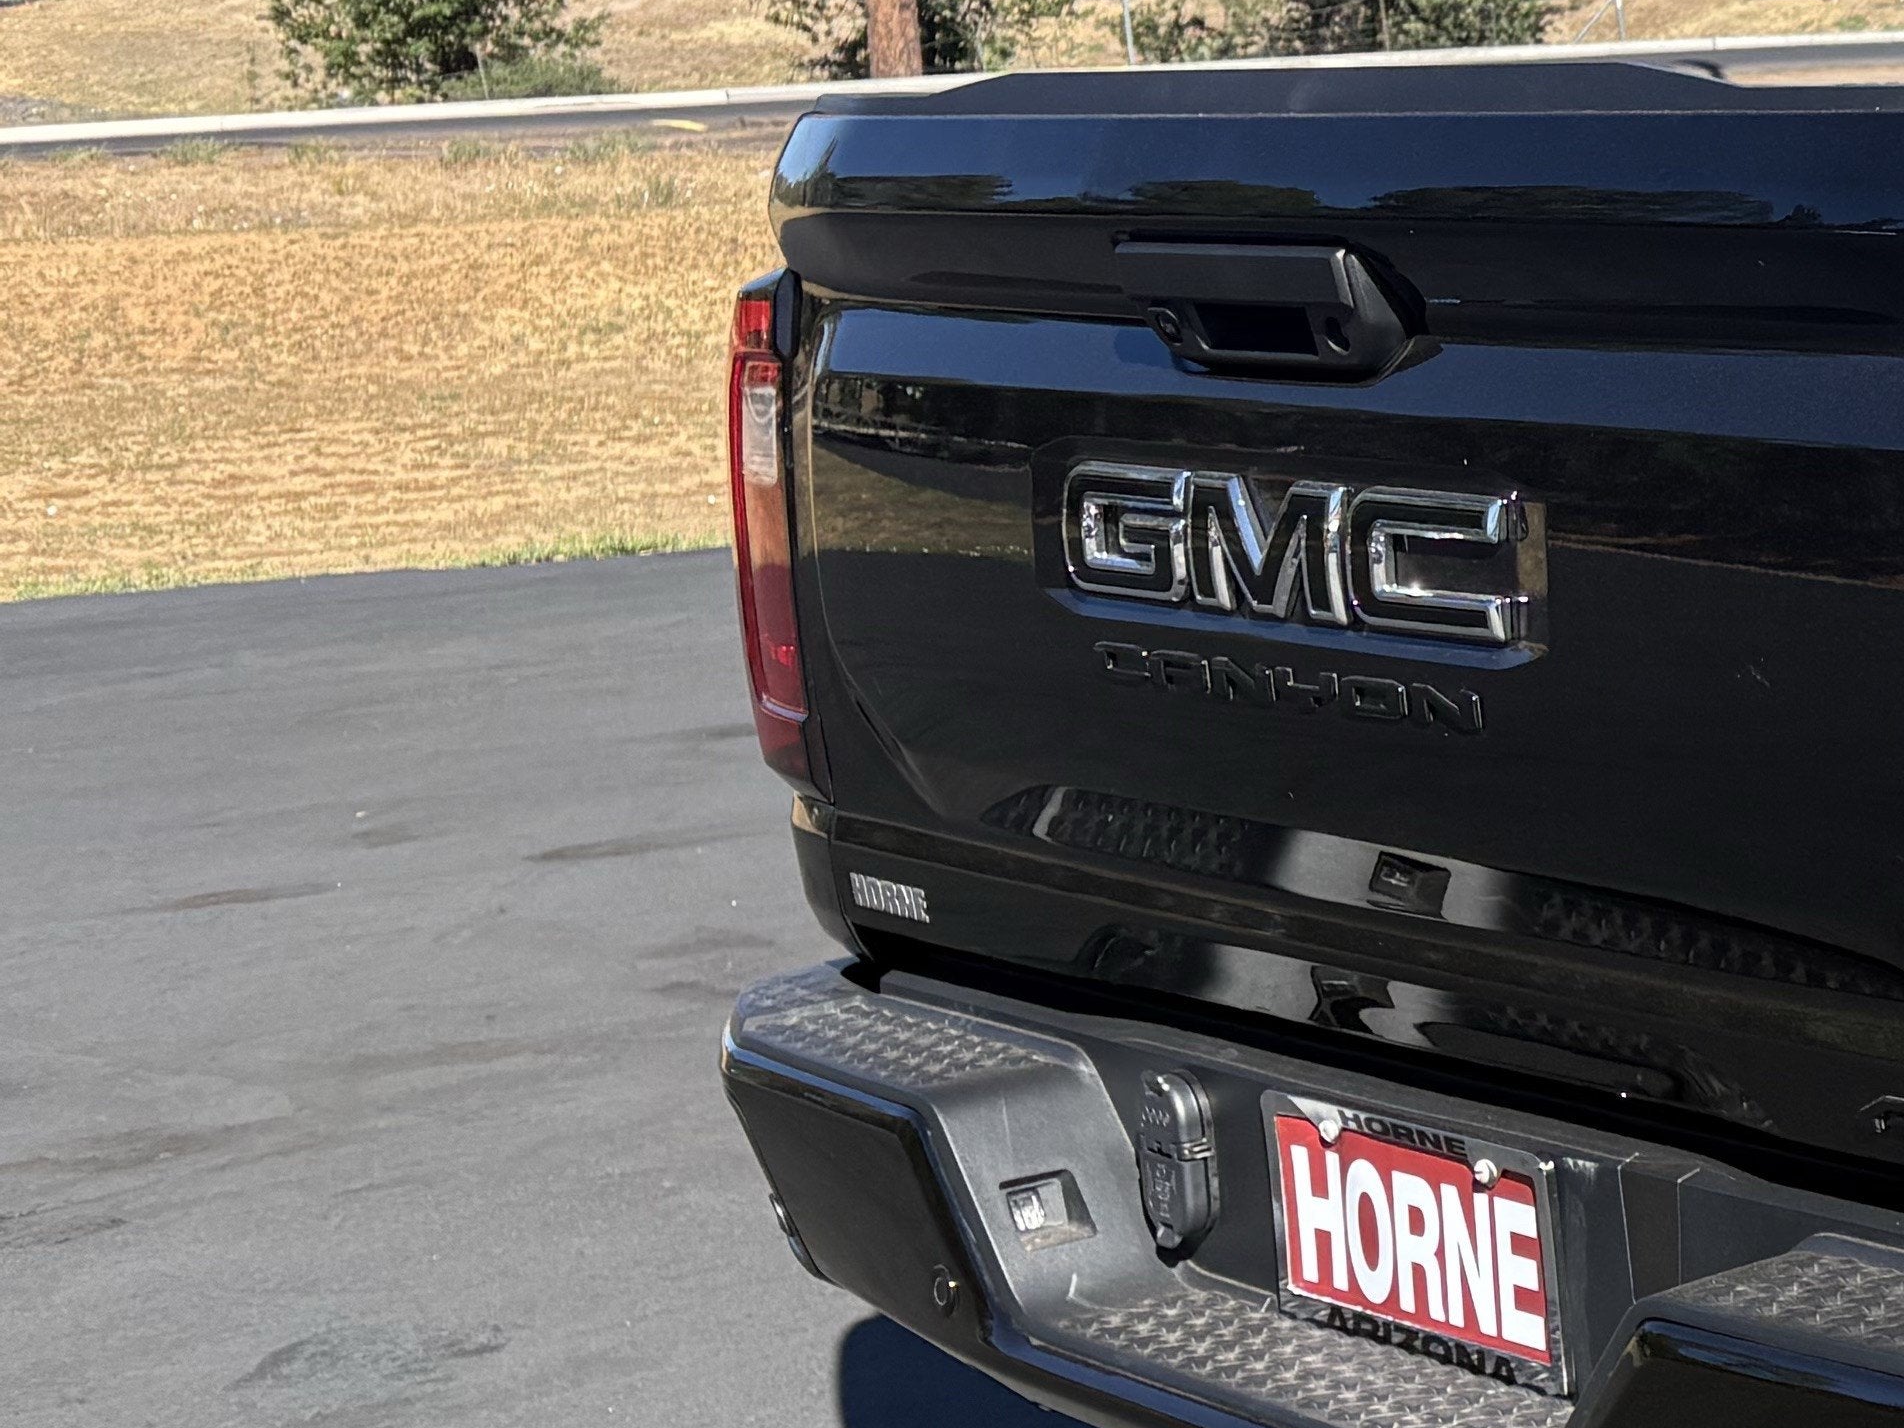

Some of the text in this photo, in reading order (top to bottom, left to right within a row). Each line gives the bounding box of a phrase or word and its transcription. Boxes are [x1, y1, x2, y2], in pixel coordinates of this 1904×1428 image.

[1061, 459, 1516, 644] GMC
[1094, 640, 1487, 733] CANYON
[849, 871, 930, 924] HORNE
[1337, 1109, 1468, 1157] HORNE
[1289, 1143, 1548, 1352] HORNE
[1325, 1304, 1518, 1385] ARIZONA
